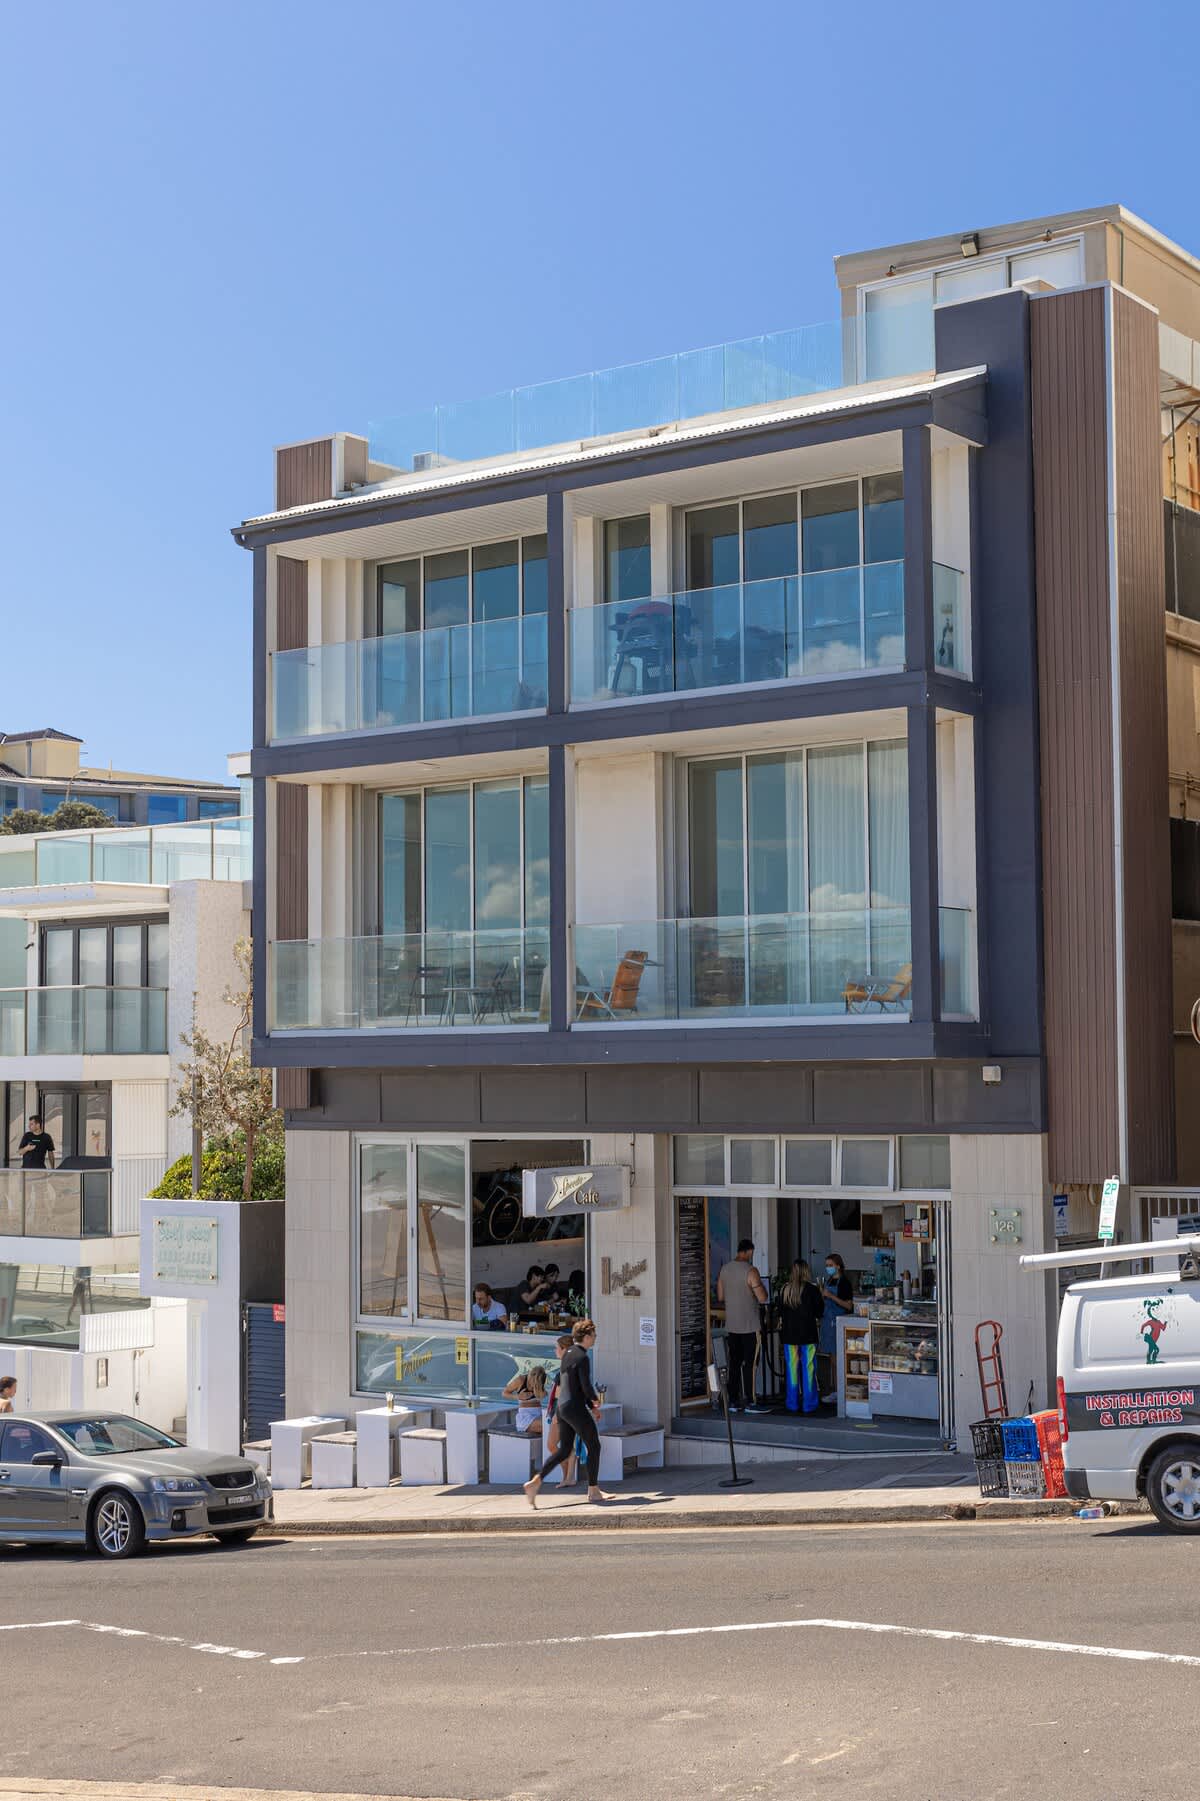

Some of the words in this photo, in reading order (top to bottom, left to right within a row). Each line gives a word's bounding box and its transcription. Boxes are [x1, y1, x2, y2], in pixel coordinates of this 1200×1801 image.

[574, 1187, 600, 1206] Cafe
[1104, 1182, 1117, 1195] 2P
[995, 1219, 1016, 1233] 126
[1086, 1389, 1195, 1411] INSTALLATION
[1100, 1411, 1116, 1426] &
[1119, 1407, 1183, 1427] REPAIRS
